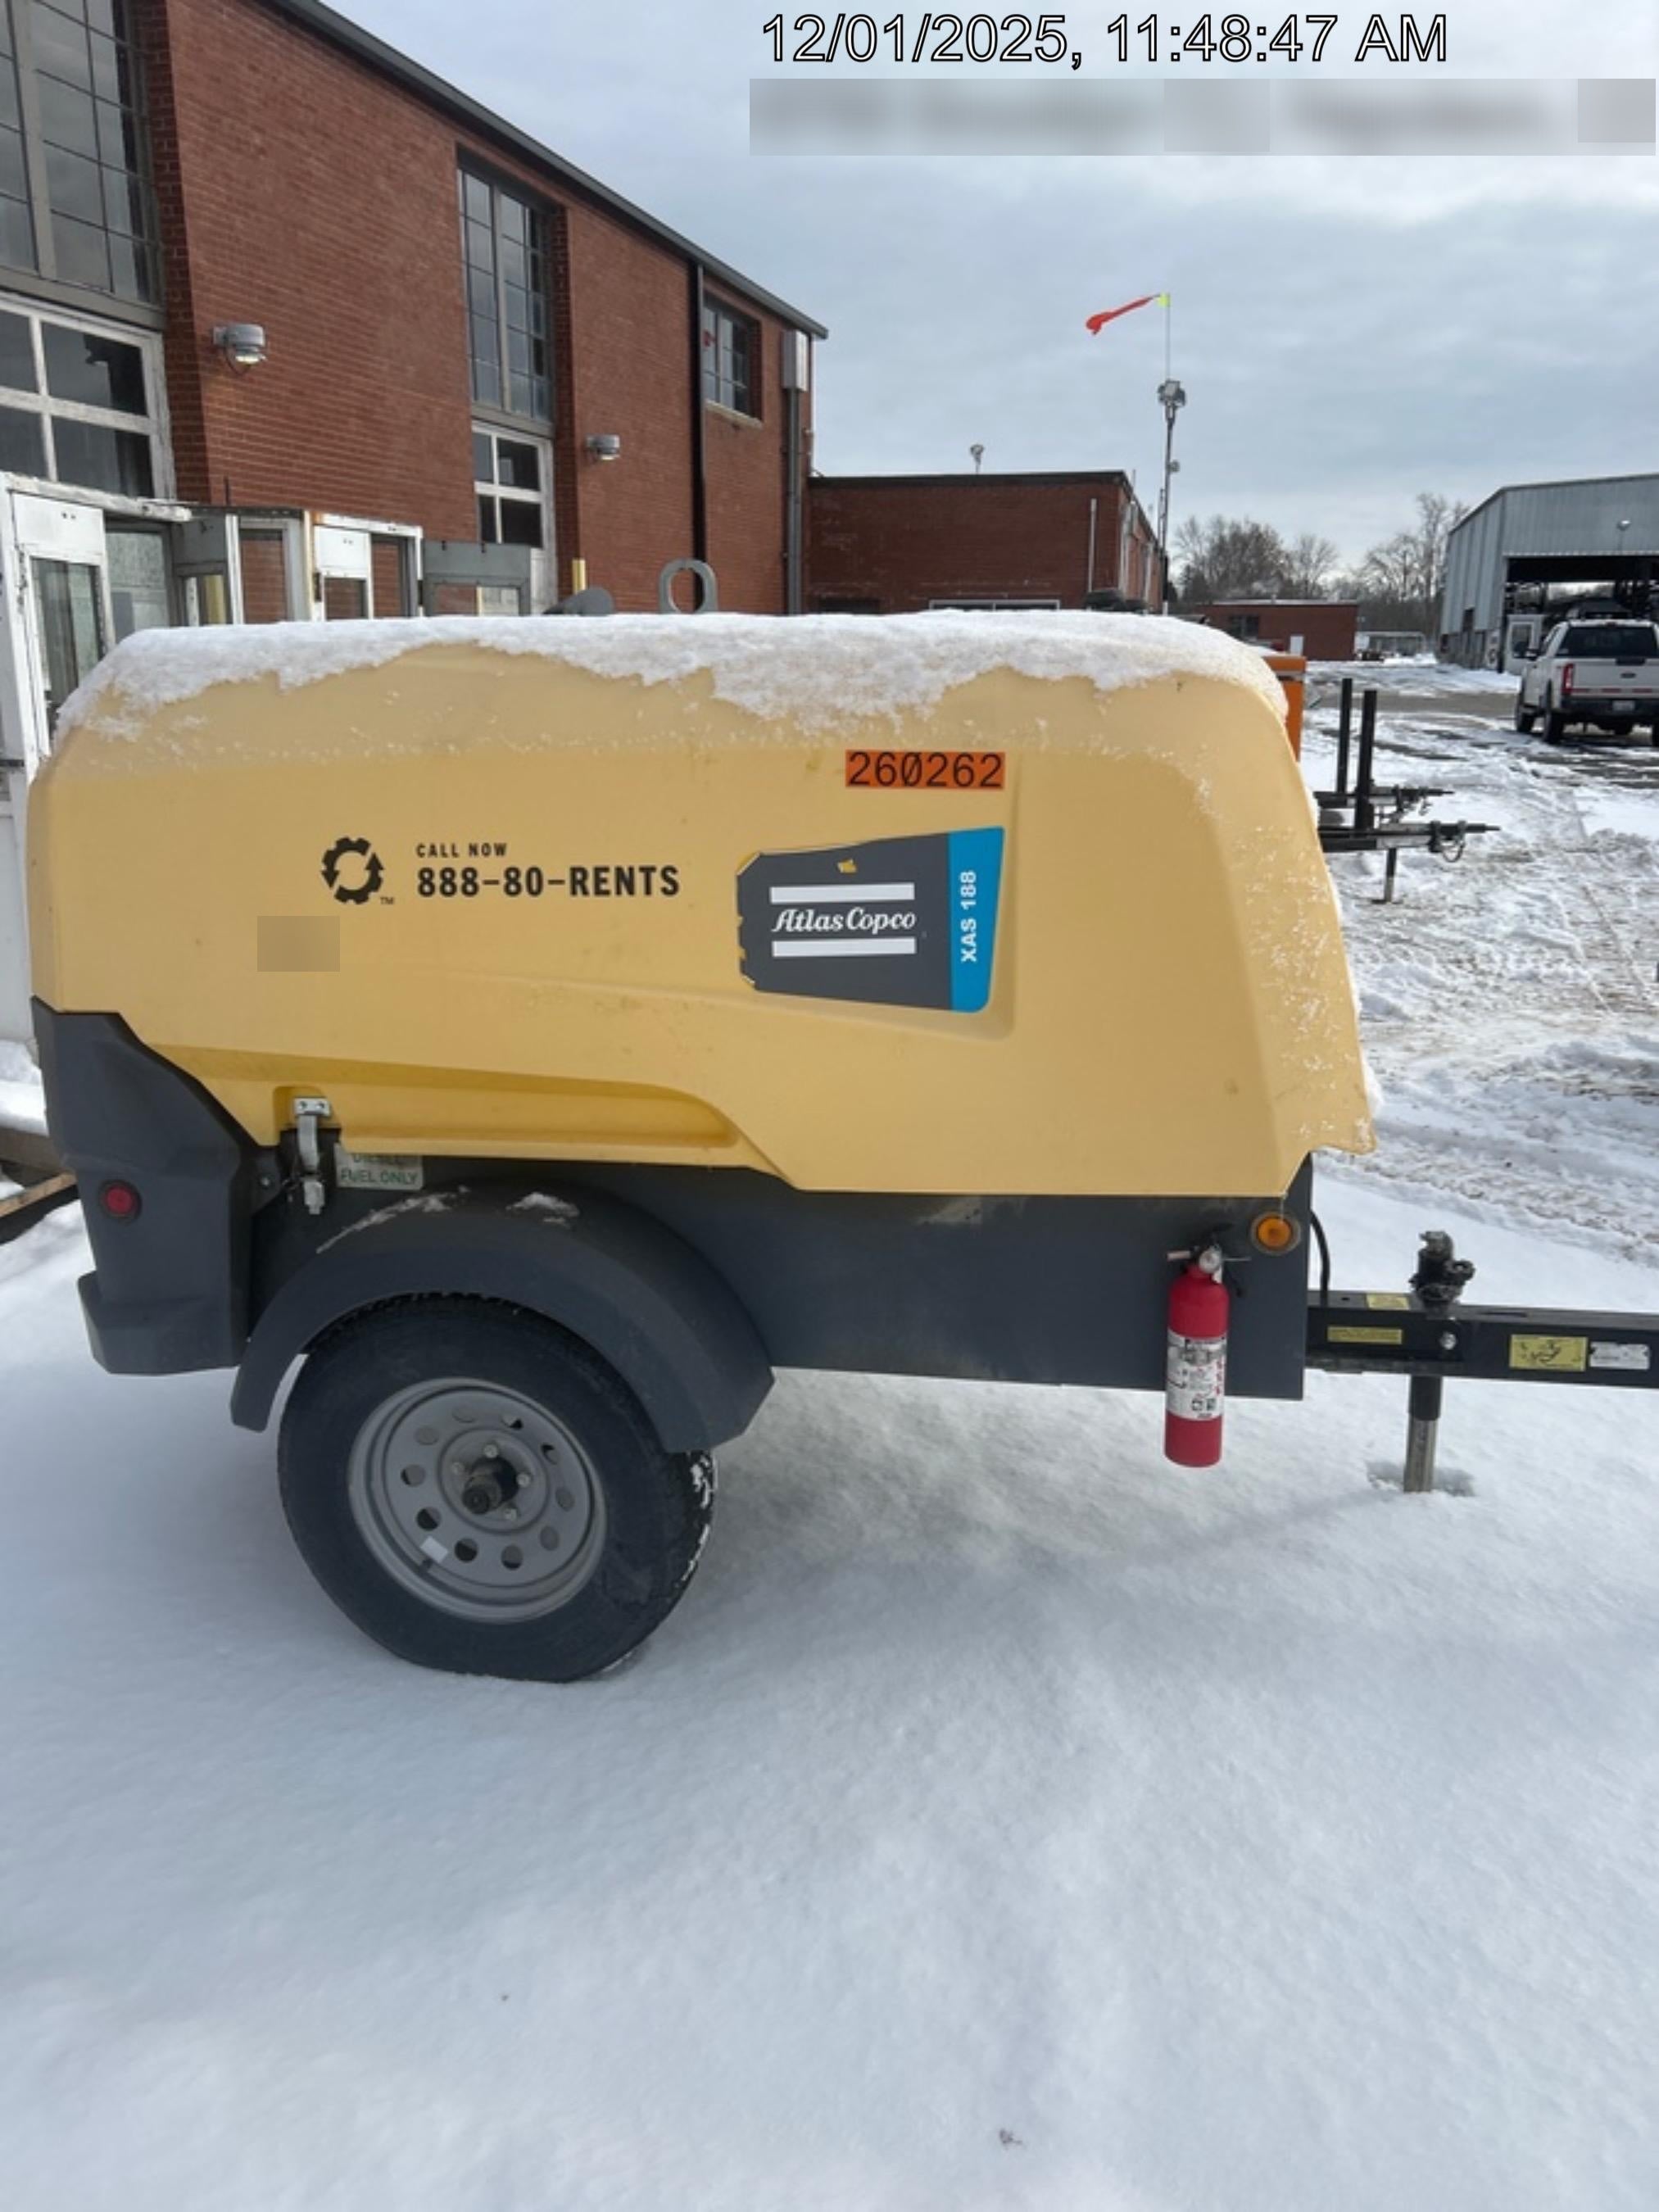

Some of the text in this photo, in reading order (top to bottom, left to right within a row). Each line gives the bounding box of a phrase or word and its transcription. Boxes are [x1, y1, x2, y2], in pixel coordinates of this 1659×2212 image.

[849, 751, 1002, 788] 260262
[416, 843, 507, 858] CALL NOW
[417, 866, 680, 897] 888-80-RENTS
[959, 870, 977, 963] XAS 188
[341, 1167, 418, 1185] FUEL ONLY
